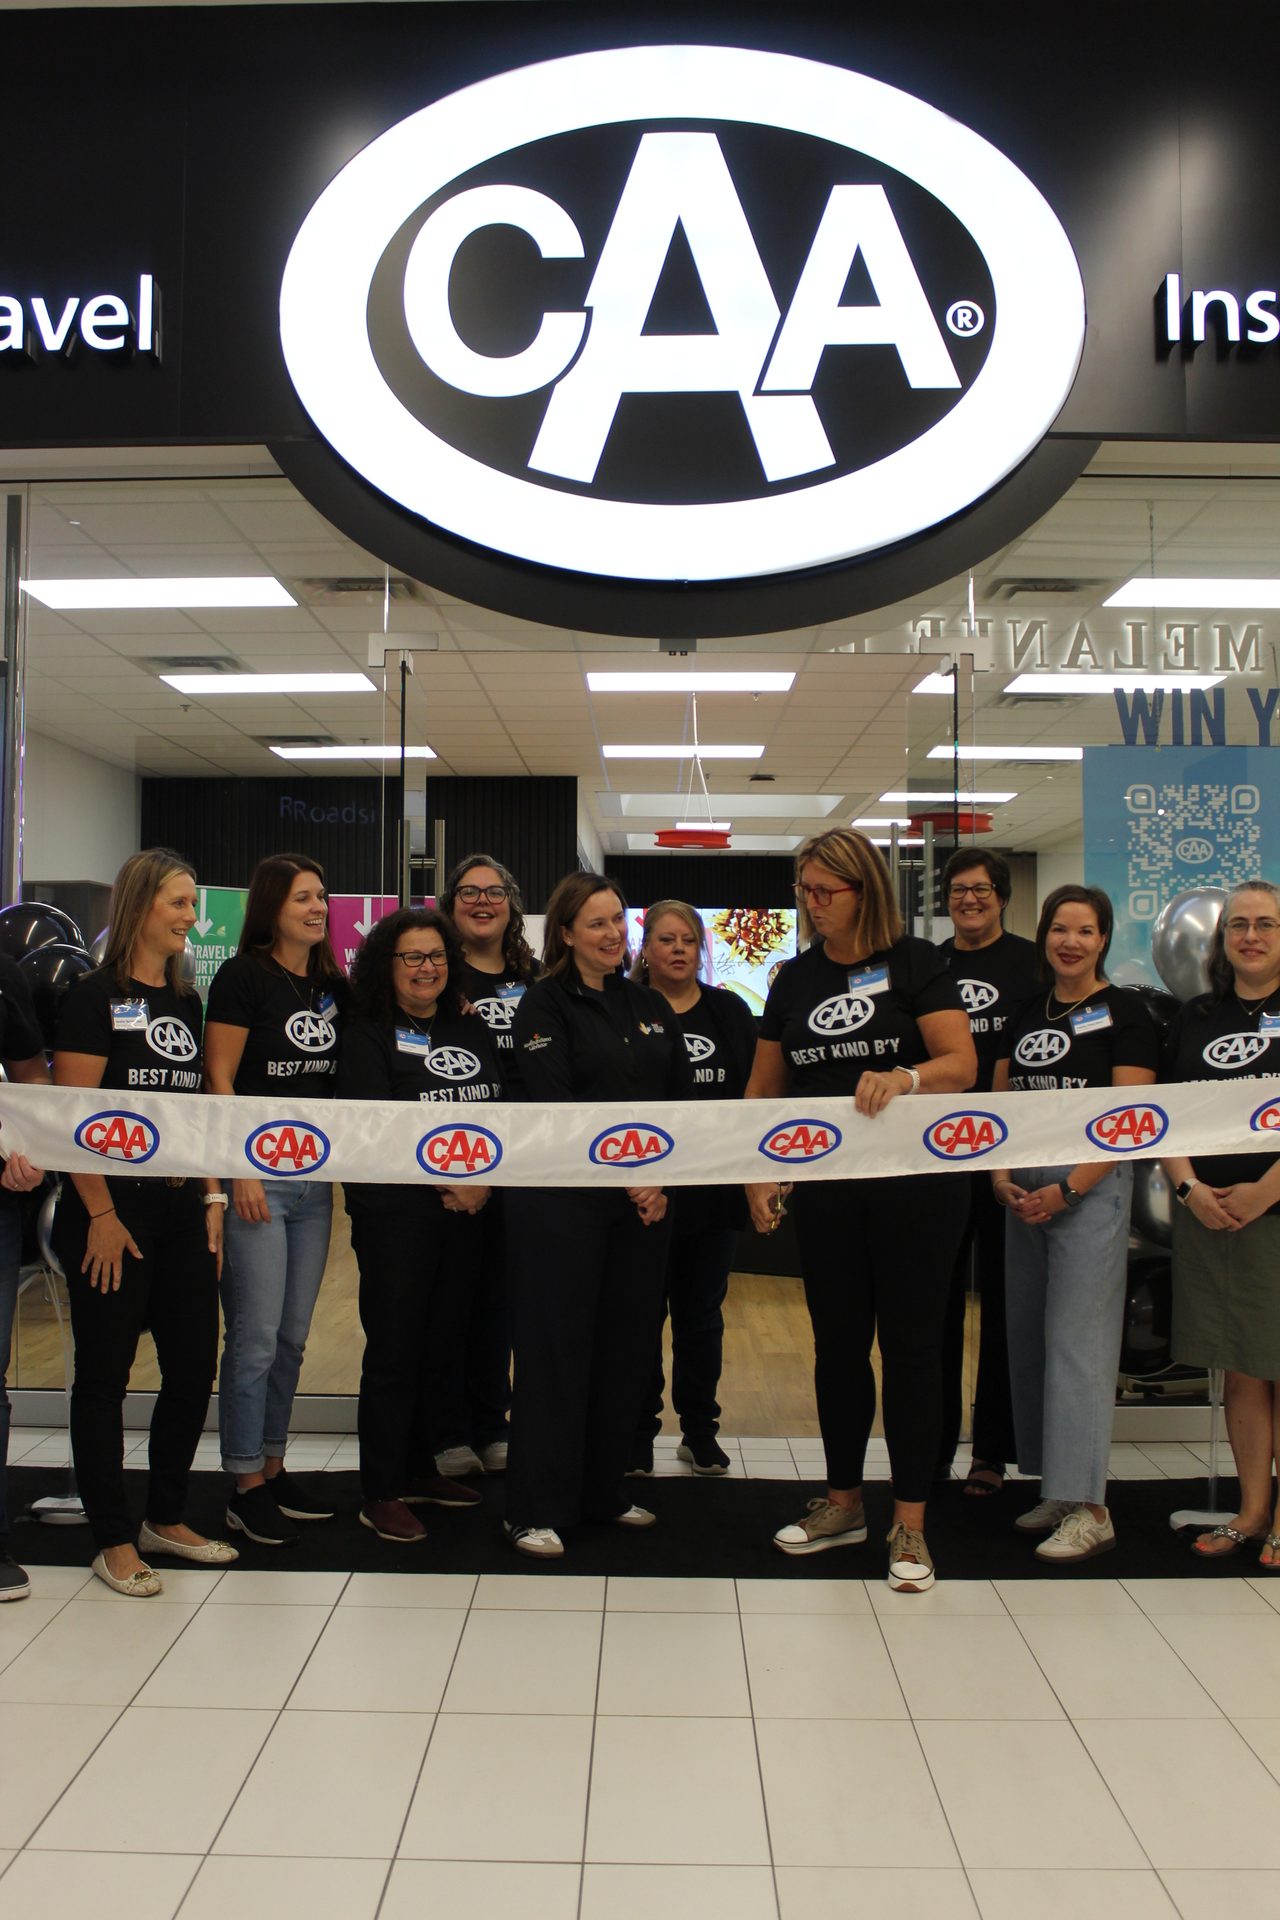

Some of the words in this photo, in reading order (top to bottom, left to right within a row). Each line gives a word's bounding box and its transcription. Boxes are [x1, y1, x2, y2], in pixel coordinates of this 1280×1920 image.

[0, 274, 153, 351] avel
[403, 130, 963, 484] CAA
[1166, 273, 1280, 342] Ins
[1113, 687, 1226, 746] WIN
[817, 999, 865, 1029] CAA
[154, 1022, 193, 1056] CAA
[293, 1016, 332, 1046] CAA
[430, 1050, 476, 1075] CAA
[790, 1047, 827, 1066] BEST
[830, 1041, 870, 1059] KIND
[873, 1037, 901, 1056] B'Y
[1021, 1034, 1062, 1061] CAA
[1211, 1036, 1261, 1063] CAA
[128, 1068, 169, 1086] BEST
[170, 1069, 197, 1089] KIND
[267, 1060, 302, 1077] BEST
[301, 1060, 331, 1075] KIND
[1028, 1075, 1058, 1091] KIND
[458, 1083, 491, 1102] KIND
[85, 1117, 148, 1159] CAA
[769, 1126, 830, 1156] CAA
[933, 1117, 996, 1154] CAA
[1095, 1109, 1157, 1145] CAA
[255, 1127, 319, 1170] CAA
[427, 1130, 491, 1172] CAA
[600, 1130, 662, 1162] CAA
